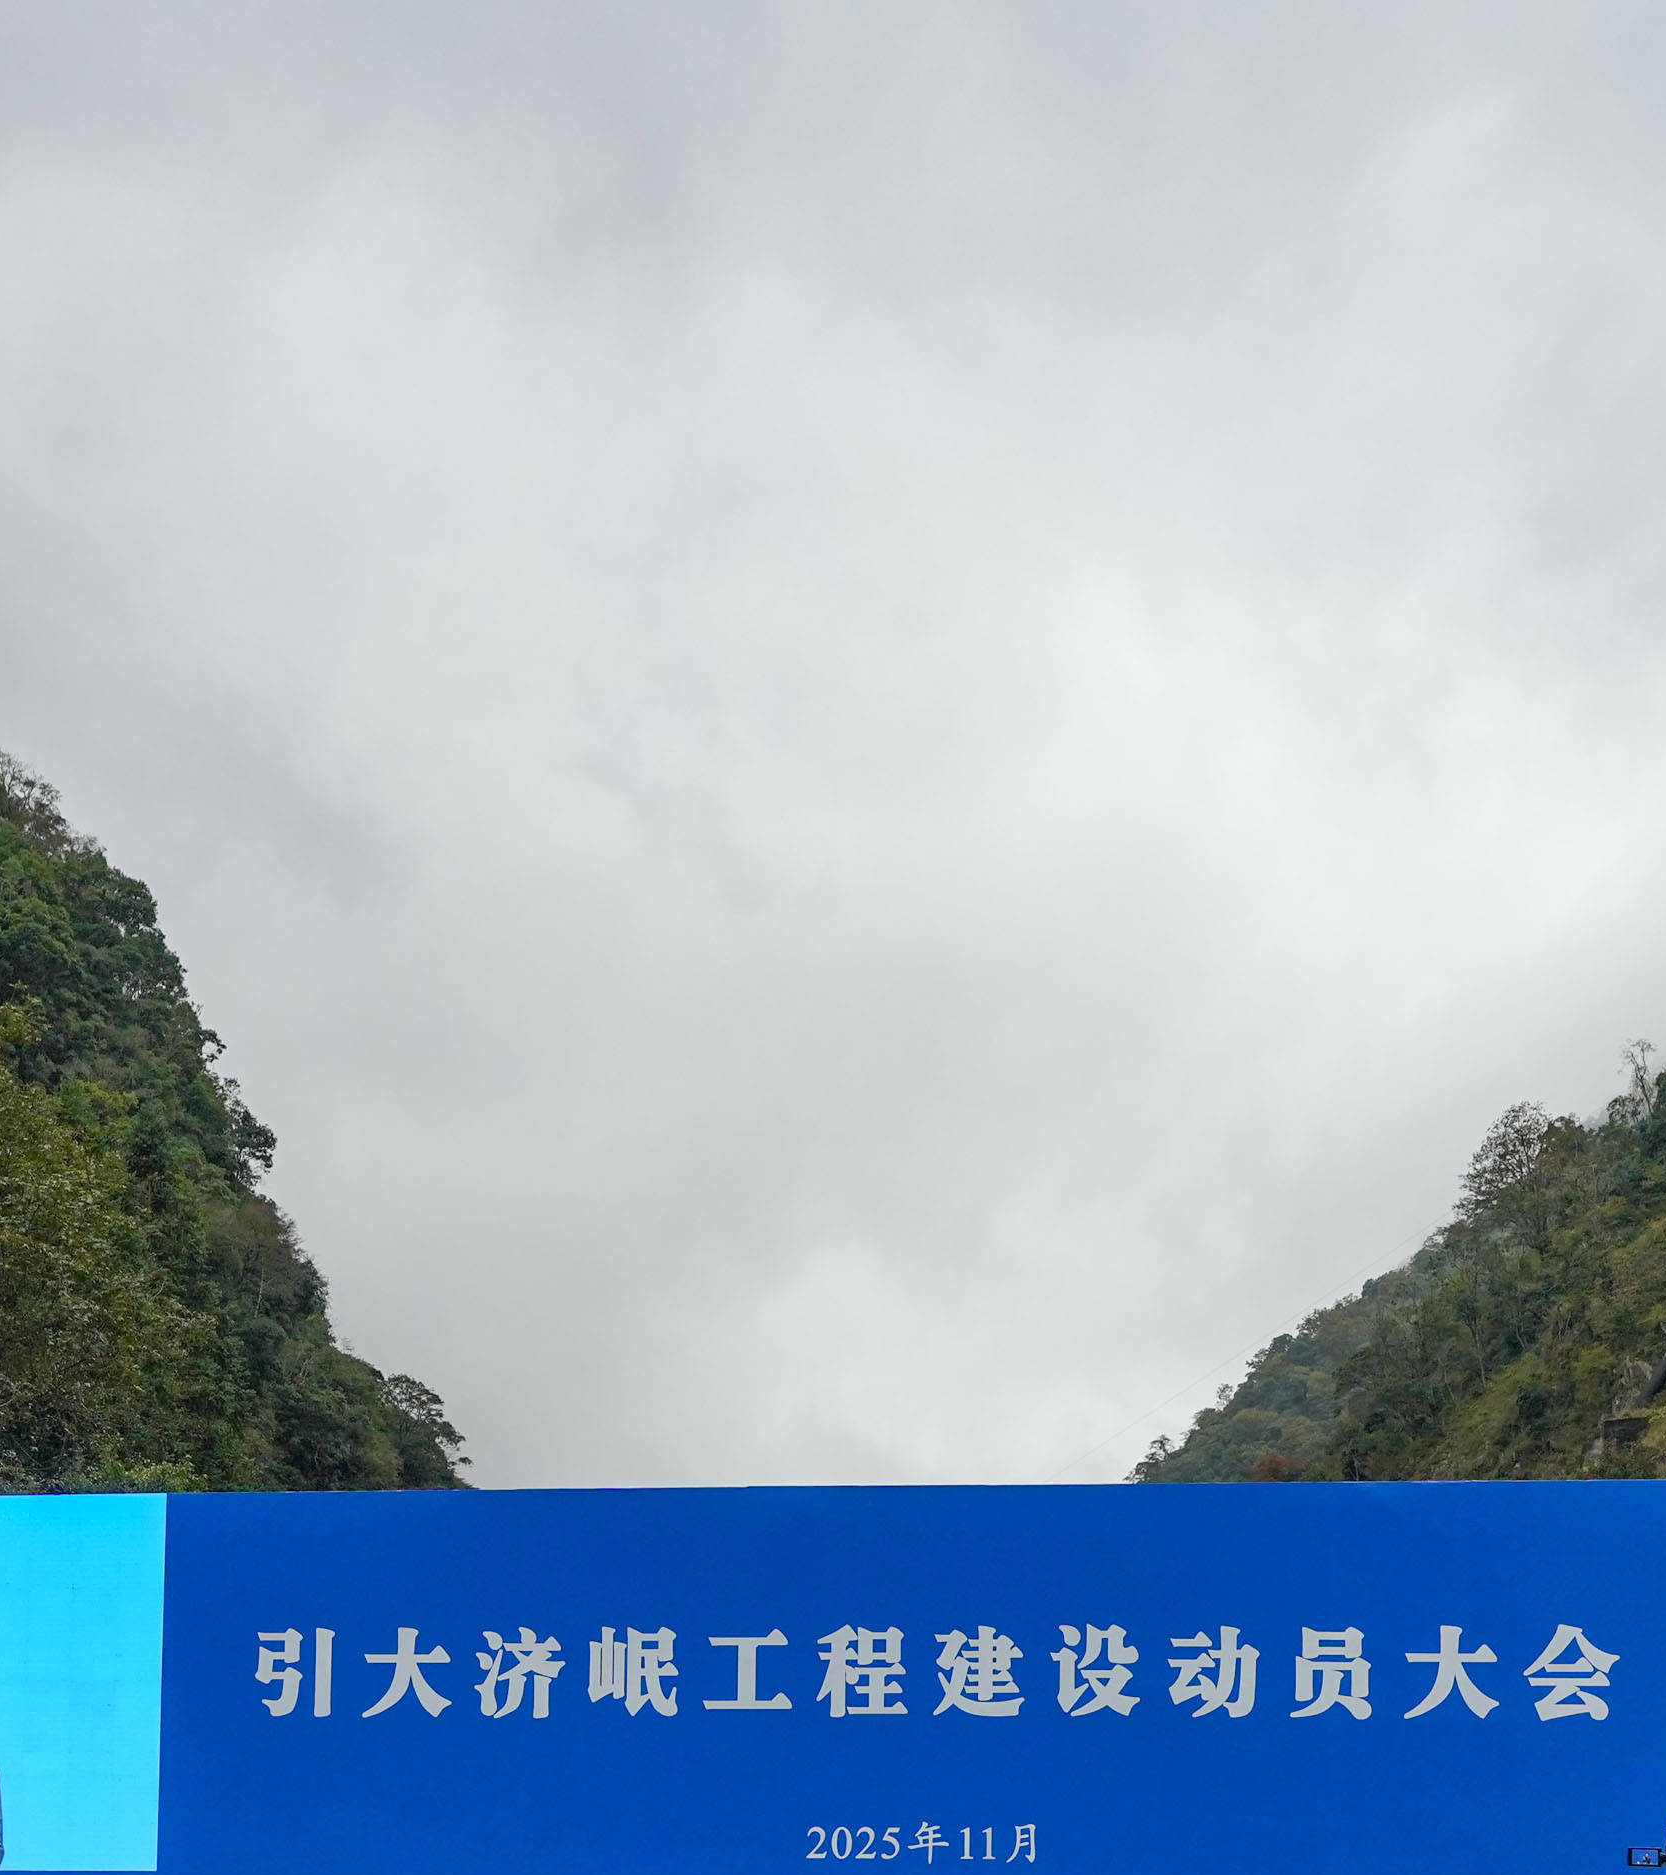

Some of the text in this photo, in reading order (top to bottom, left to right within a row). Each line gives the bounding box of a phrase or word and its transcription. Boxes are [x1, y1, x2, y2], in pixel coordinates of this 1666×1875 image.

[254, 1623, 1621, 1722] 引大济岷工程建设动员大会
[805, 1821, 1039, 1865] 2025年11月
